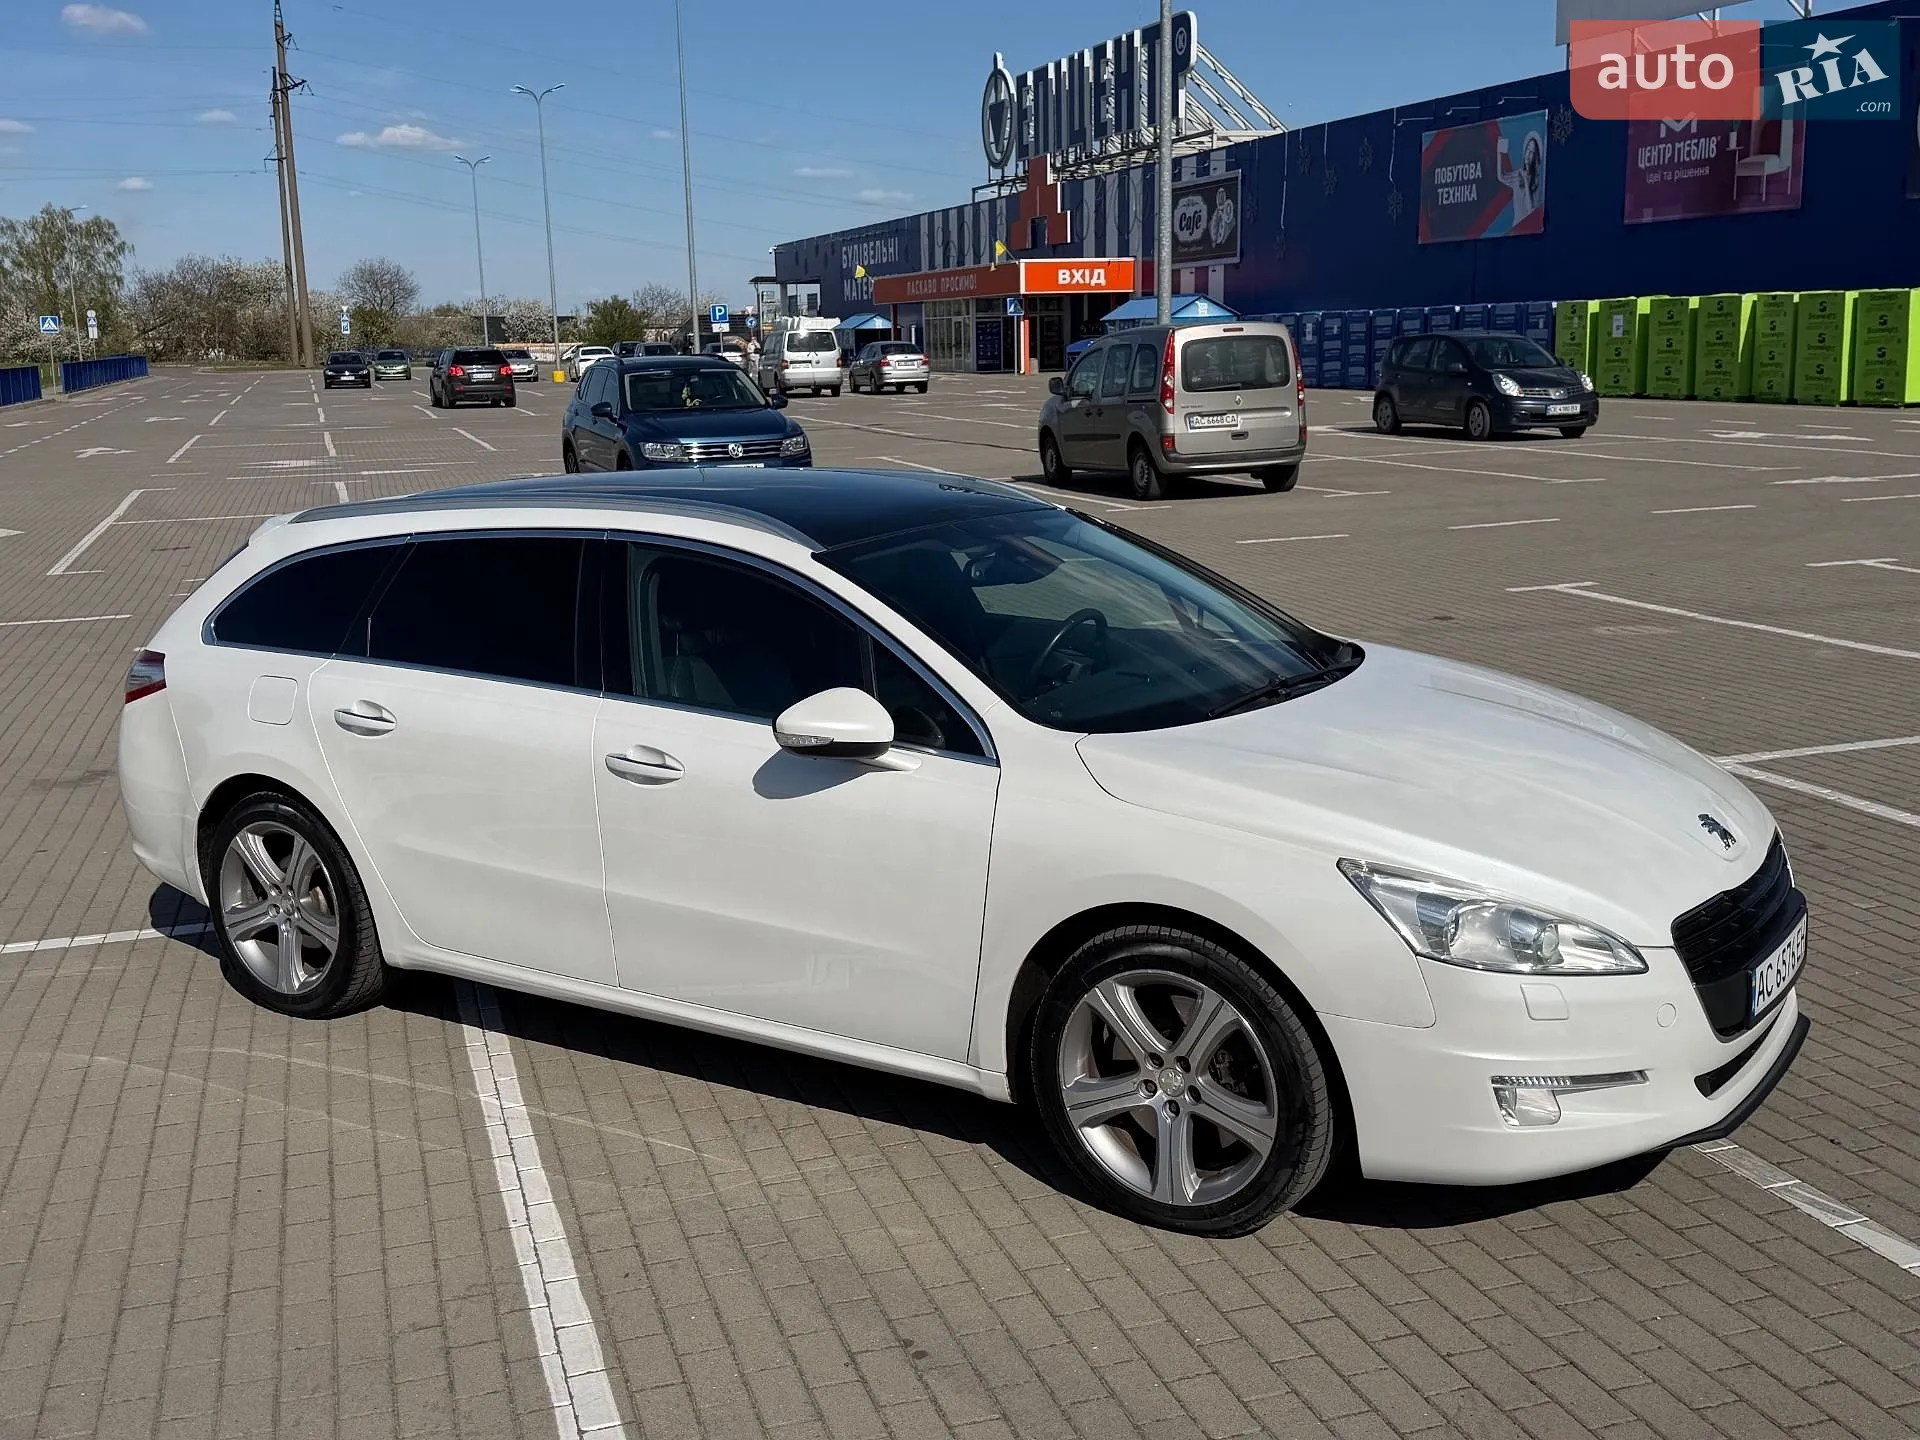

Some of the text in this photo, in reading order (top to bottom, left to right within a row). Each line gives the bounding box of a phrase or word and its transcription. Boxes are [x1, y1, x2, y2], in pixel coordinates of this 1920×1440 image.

[1637, 136, 1718, 170] ЦЕНТР МЕБЛІВ
[1434, 161, 1482, 185] ПОБУТОВА
[1664, 171, 1673, 181] та
[1674, 166, 1710, 182] рішення
[1437, 183, 1478, 205] ТЕХНІКА
[1179, 209, 1202, 236] Café
[842, 237, 899, 269] БУДІВЕЛЬНІ
[907, 273, 977, 296] ЛАСКАВО ПРОСИМО!
[1057, 268, 1106, 287] ВХІД
[1195, 415, 1236, 425] AC 6668 CA
[1756, 962, 1774, 1008] AC
[1776, 936, 1796, 989] 6576
